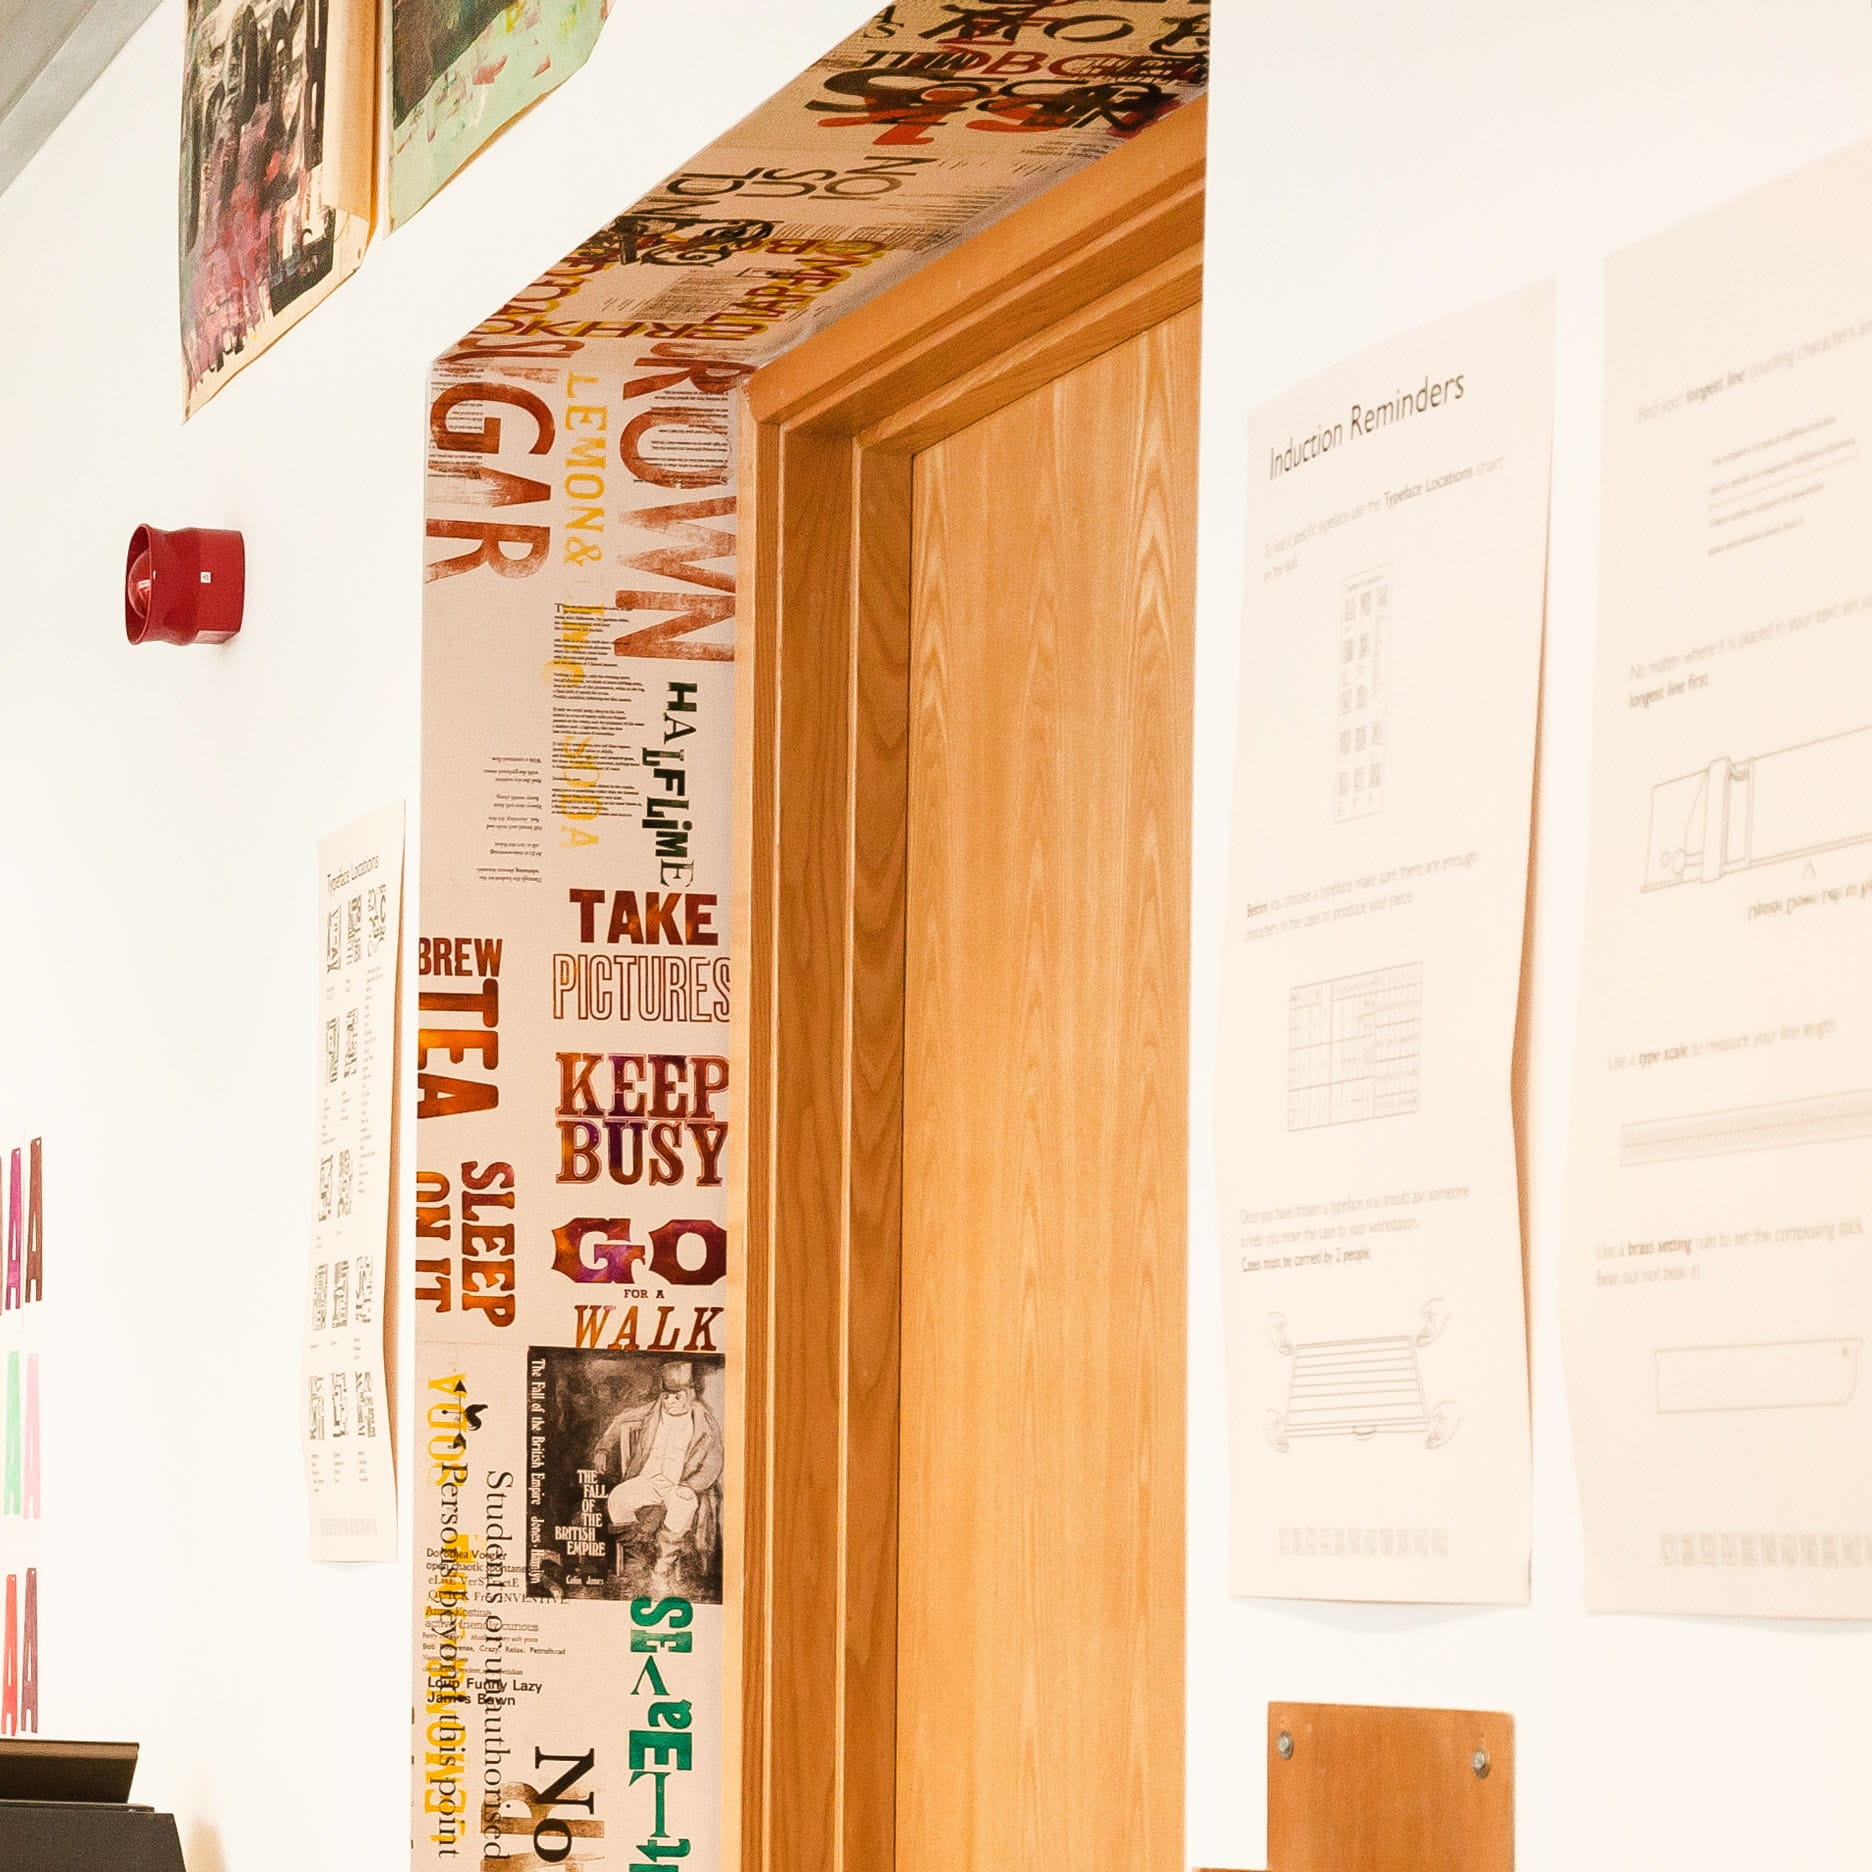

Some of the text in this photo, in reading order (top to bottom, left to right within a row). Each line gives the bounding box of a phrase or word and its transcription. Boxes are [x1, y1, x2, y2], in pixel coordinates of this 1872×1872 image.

[1267, 369, 1468, 482] Induction Reminders
[1382, 464, 1474, 512] Typeface Locations
[569, 889, 720, 946] TAKE
[417, 937, 503, 978] BREW
[552, 953, 731, 1024] PICTURES
[417, 977, 500, 1120] TEA
[555, 1052, 730, 1119] KEEP
[555, 1119, 729, 1187] BUSY
[460, 1160, 516, 1328] SLEEP
[551, 1216, 727, 1286] GO
[623, 1288, 666, 1299] FOR A
[573, 1305, 725, 1352] WALK
[528, 1359, 546, 1507] The Fall of the British Empire
[576, 1469, 598, 1485] THE
[583, 1484, 609, 1499] FALL
[581, 1499, 595, 1513] OF
[583, 1513, 603, 1528] THE
[555, 1526, 596, 1542] BRITISH
[567, 1541, 606, 1557] EMPIRE
[585, 1575, 605, 1586] Jones
[431, 1462, 469, 1860] Persons beyond this point
[481, 1471, 514, 1861] Students or unauthorised
[426, 1691, 472, 1705] James
[466, 1677, 543, 1695] Funny Lazy
[534, 1745, 596, 1864] No
